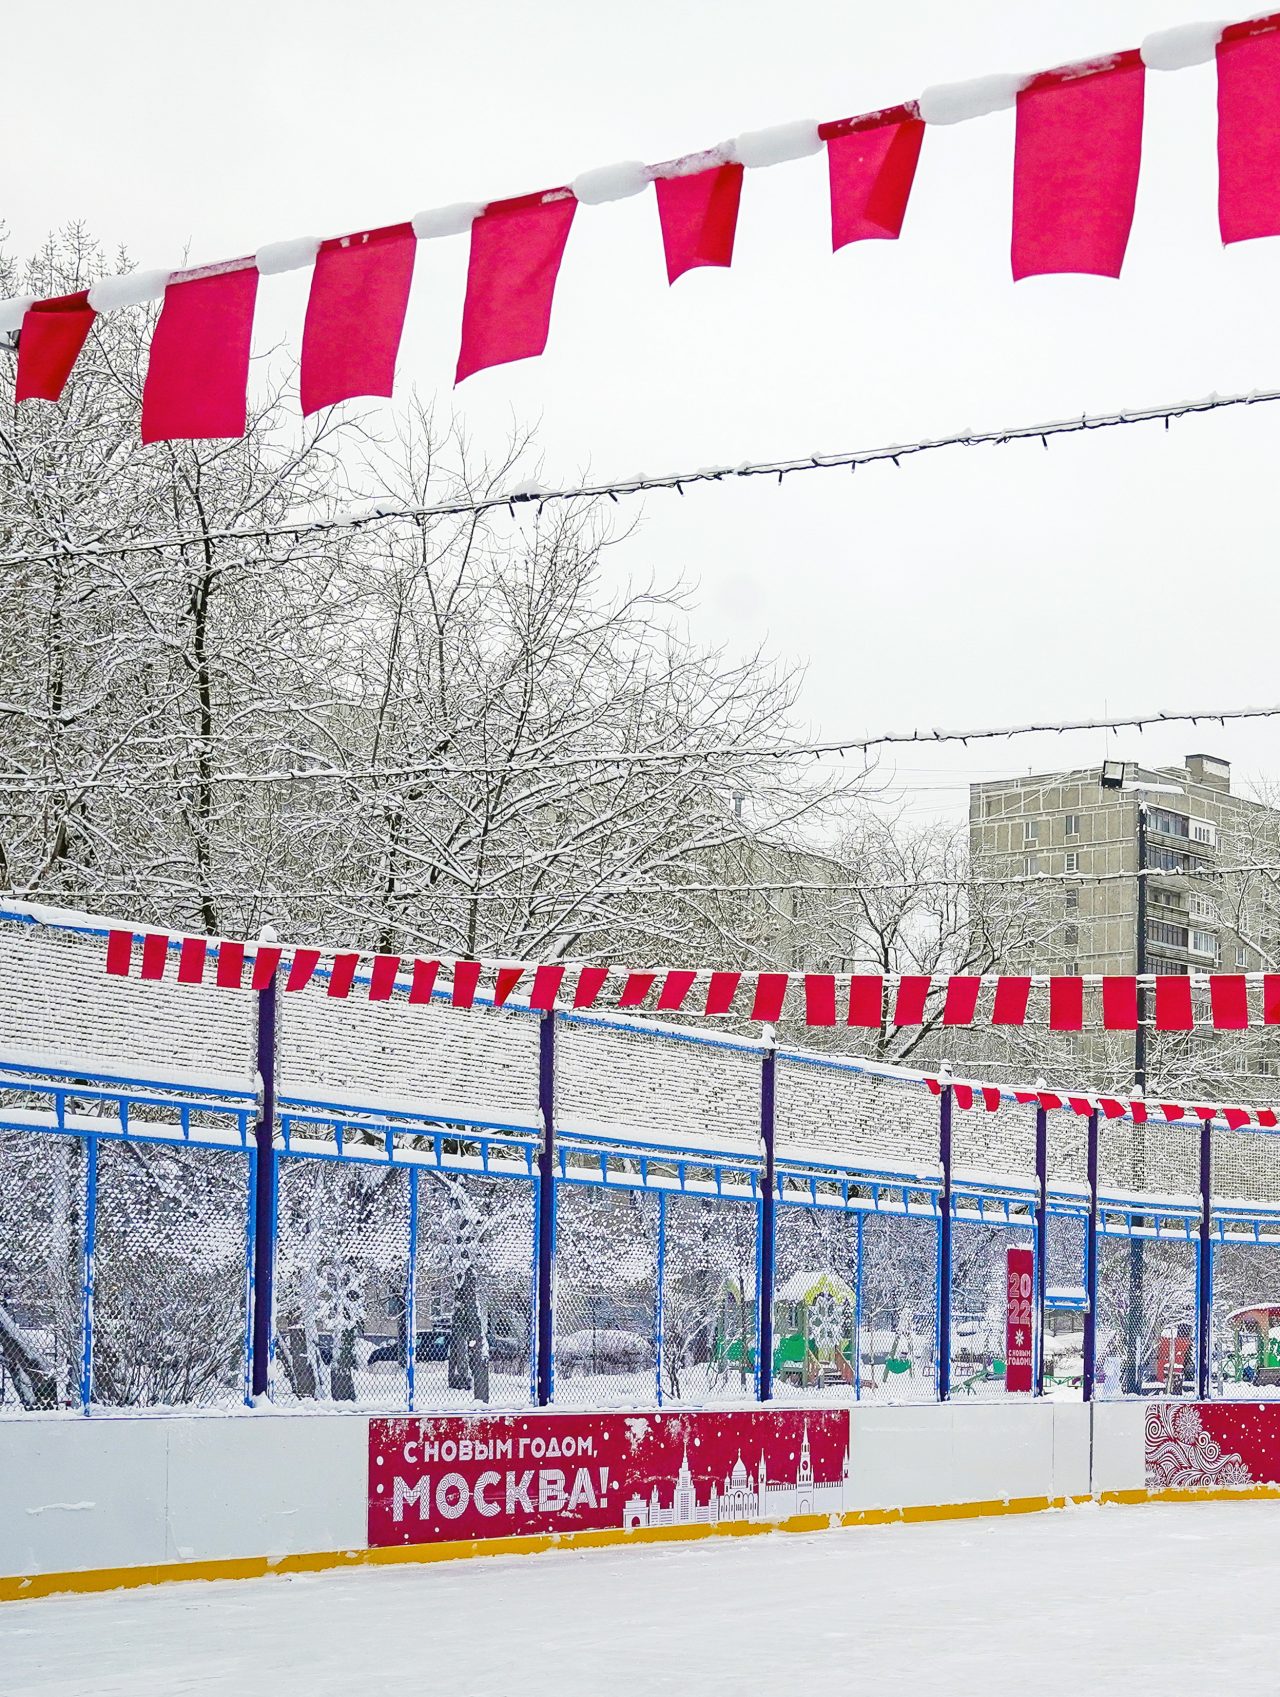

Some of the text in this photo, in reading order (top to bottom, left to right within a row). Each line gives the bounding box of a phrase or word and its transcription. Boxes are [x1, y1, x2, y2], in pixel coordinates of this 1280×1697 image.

[1009, 1272, 1032, 1298] 20
[1009, 1299, 1031, 1325] 22
[403, 1436, 598, 1463] С НОВЫМ ГОДОМ,
[392, 1466, 610, 1522] МОСКВА!
